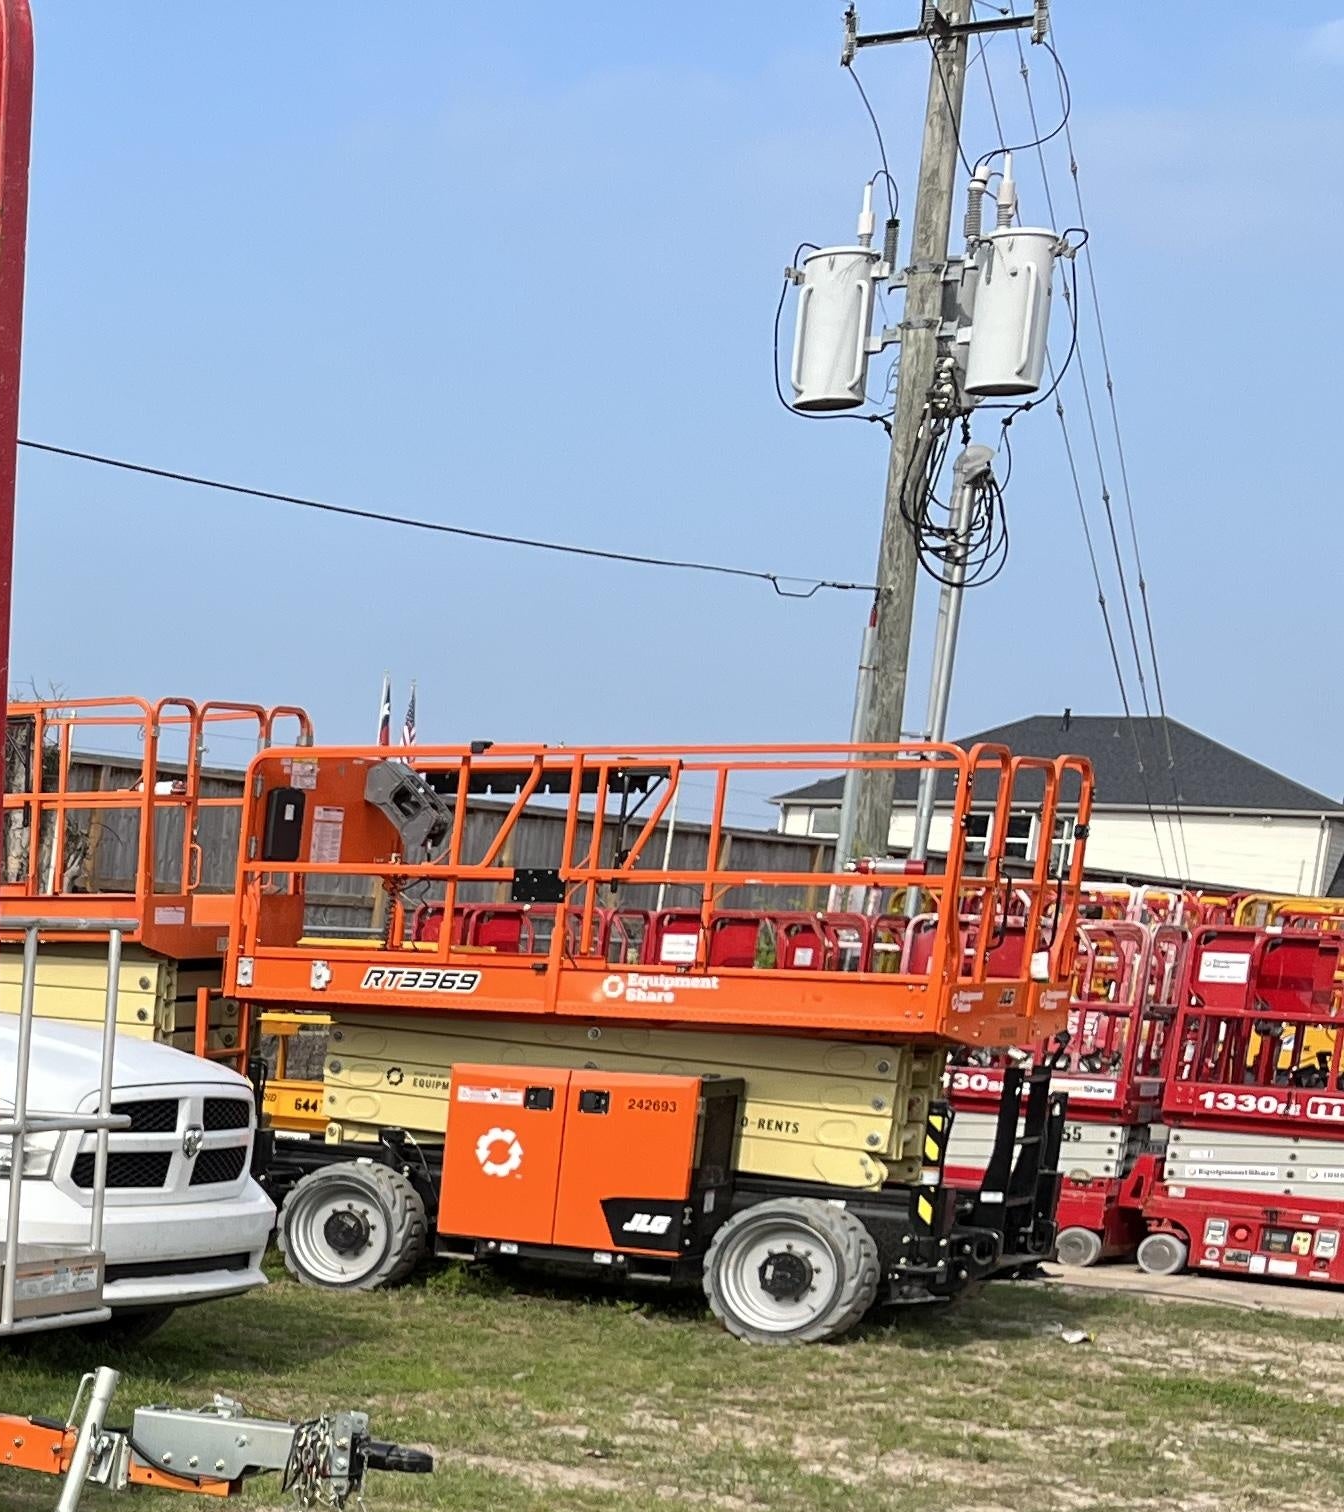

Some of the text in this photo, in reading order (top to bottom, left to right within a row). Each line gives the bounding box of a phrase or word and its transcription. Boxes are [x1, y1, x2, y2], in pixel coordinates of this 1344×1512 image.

[363, 969, 479, 991] RT3369
[627, 973, 720, 990] Equipment
[625, 988, 675, 1003] Share
[627, 1098, 677, 1113] 242693
[622, 1212, 673, 1235] JLG
